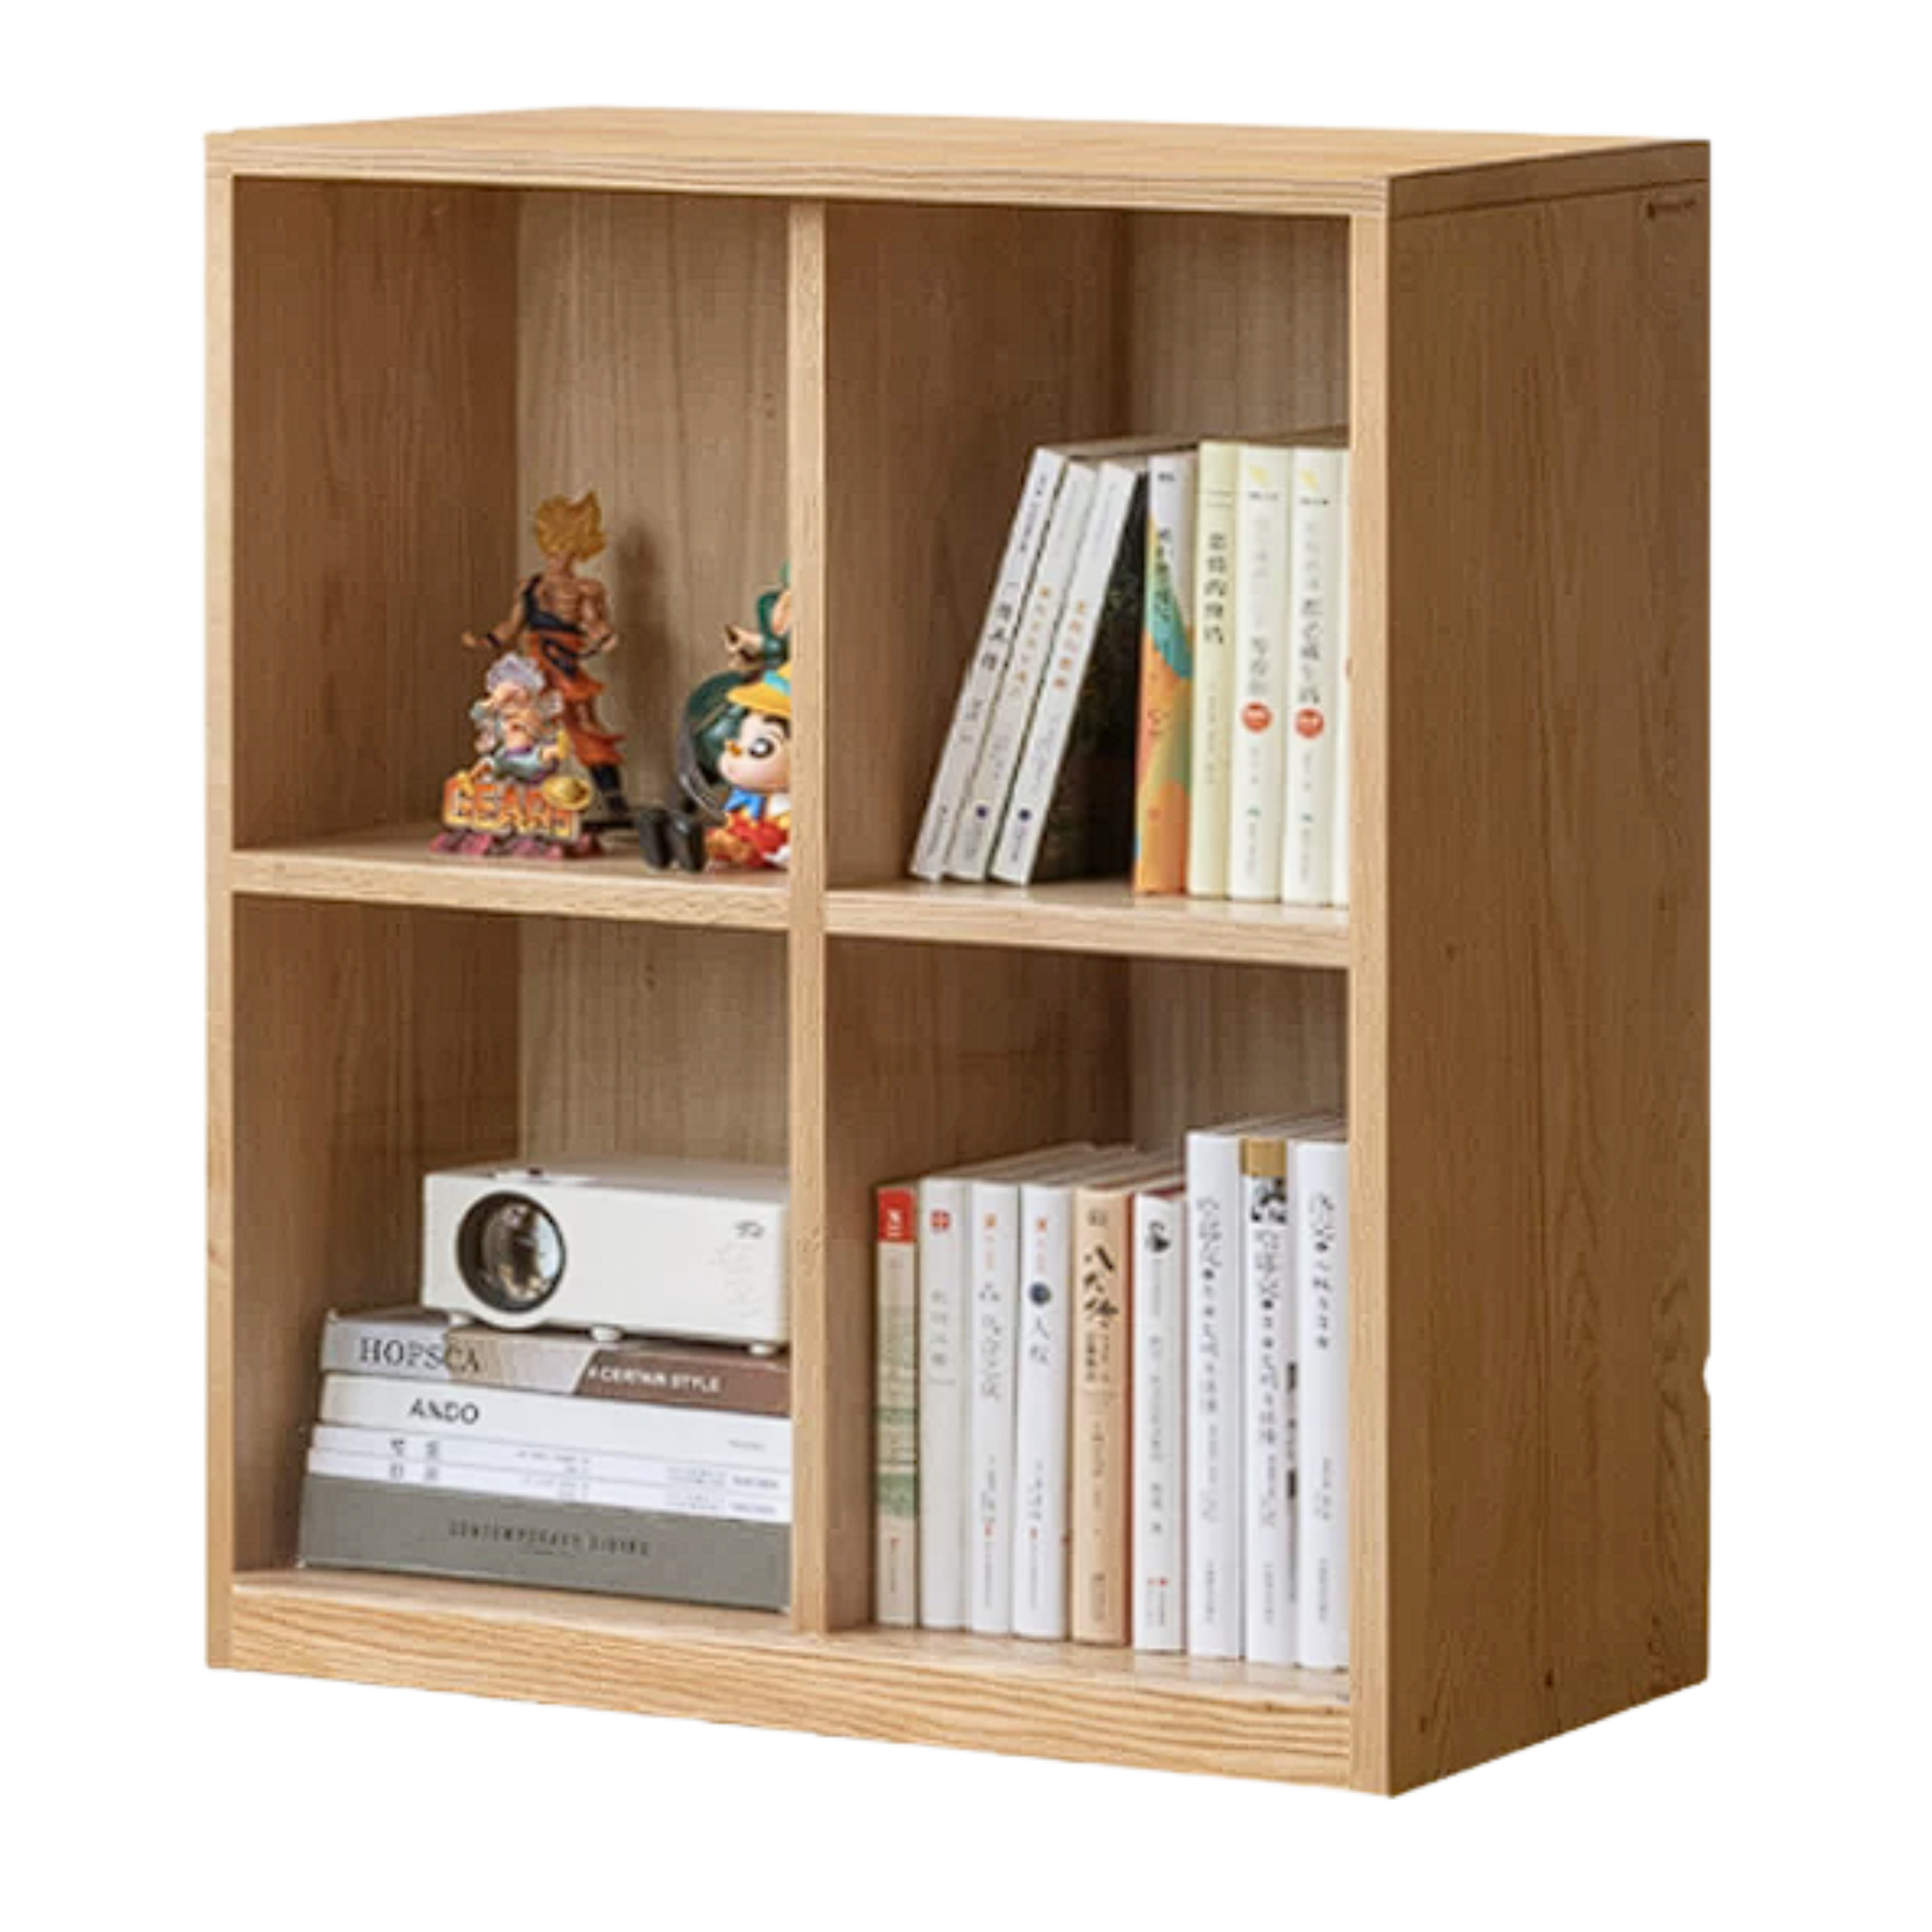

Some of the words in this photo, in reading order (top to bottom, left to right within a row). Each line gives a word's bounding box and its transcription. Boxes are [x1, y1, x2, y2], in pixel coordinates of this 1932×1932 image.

[359, 1337, 480, 1372] HOPSCA
[672, 1373, 720, 1393] STYLE
[408, 1398, 480, 1425] ANDO
